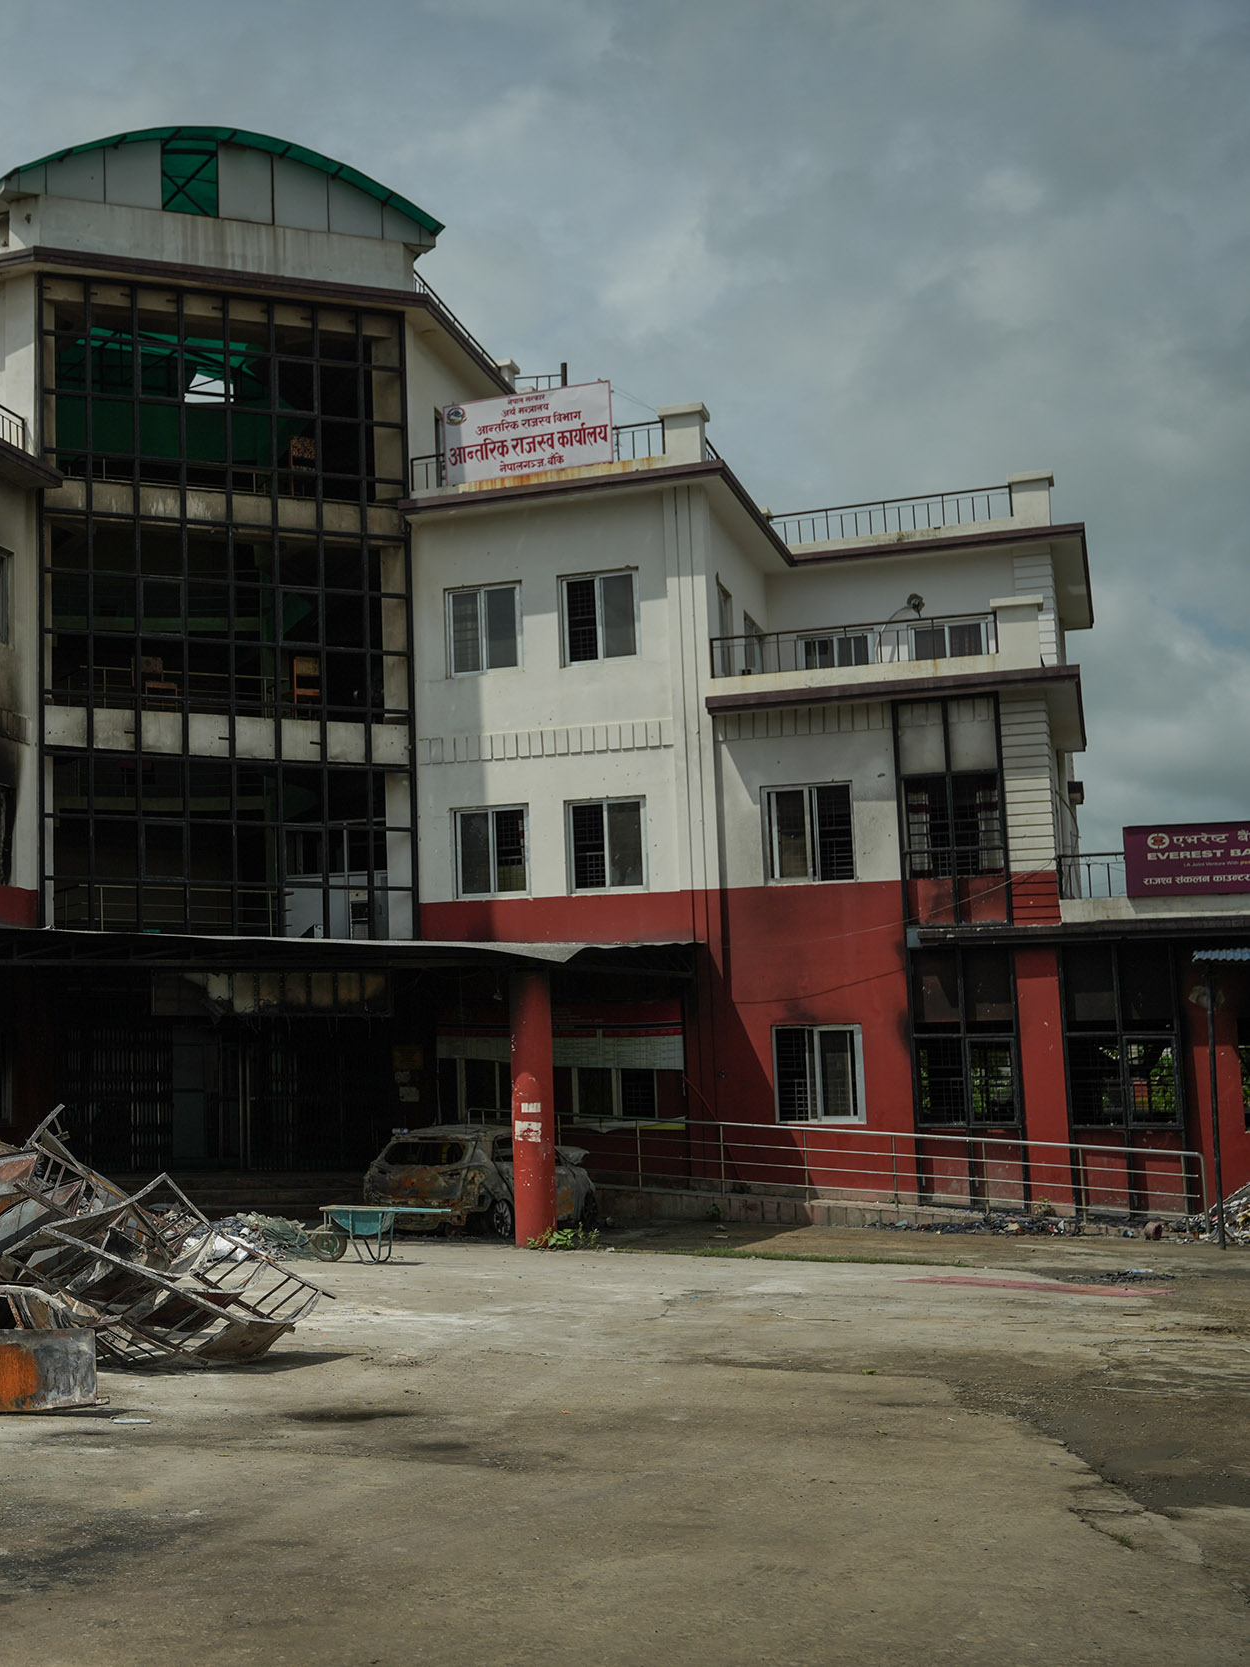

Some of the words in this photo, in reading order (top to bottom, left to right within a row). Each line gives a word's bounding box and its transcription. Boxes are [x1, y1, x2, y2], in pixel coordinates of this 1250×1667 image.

[475, 419, 519, 436] आन्तरिक
[521, 414, 551, 429] राजस्व
[553, 410, 582, 424] विभाग
[448, 437, 509, 466] आन्तरिक
[511, 432, 555, 457] राजस्व
[557, 422, 609, 447] कार्यालय
[1172, 832, 1229, 847] एभरेष्ट
[1237, 829, 1250, 842] बैं
[1147, 849, 1225, 861] EVEREST
[1174, 874, 1210, 884] संकलन
